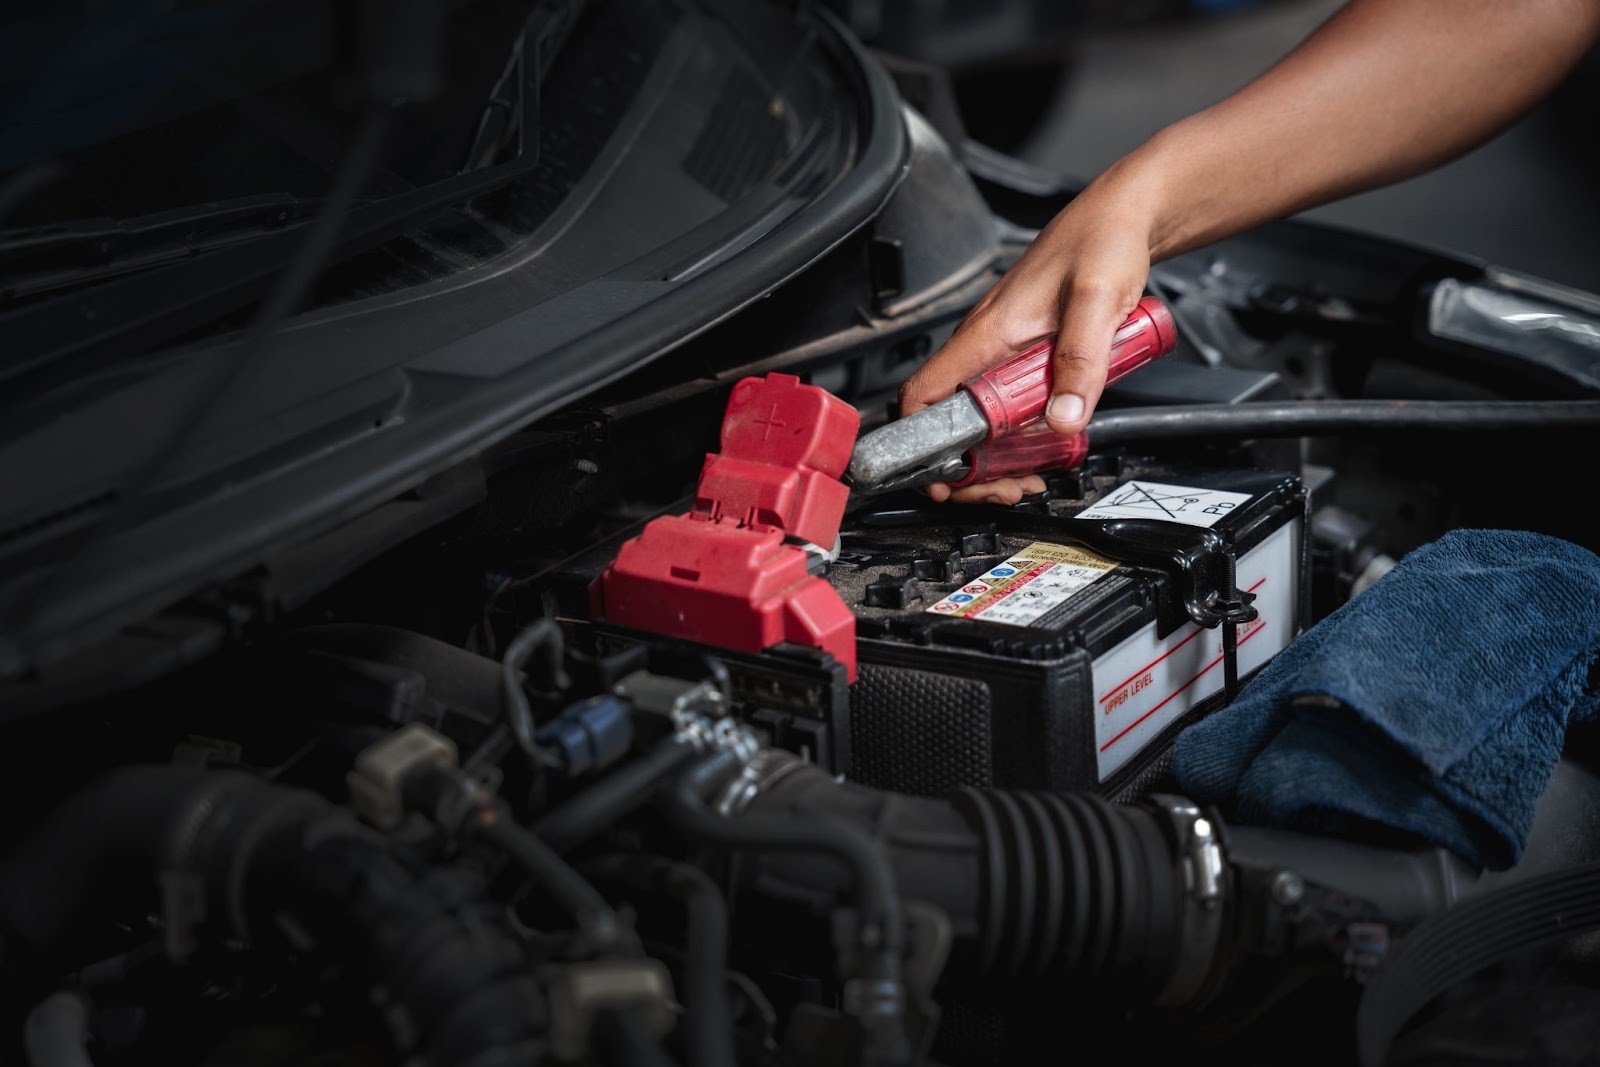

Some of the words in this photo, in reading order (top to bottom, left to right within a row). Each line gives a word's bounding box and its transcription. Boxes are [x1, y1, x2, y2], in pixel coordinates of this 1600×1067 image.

[1201, 502, 1236, 515] Pb
[1105, 689, 1128, 715] UPPER
[1131, 673, 1154, 696] LEVEL
